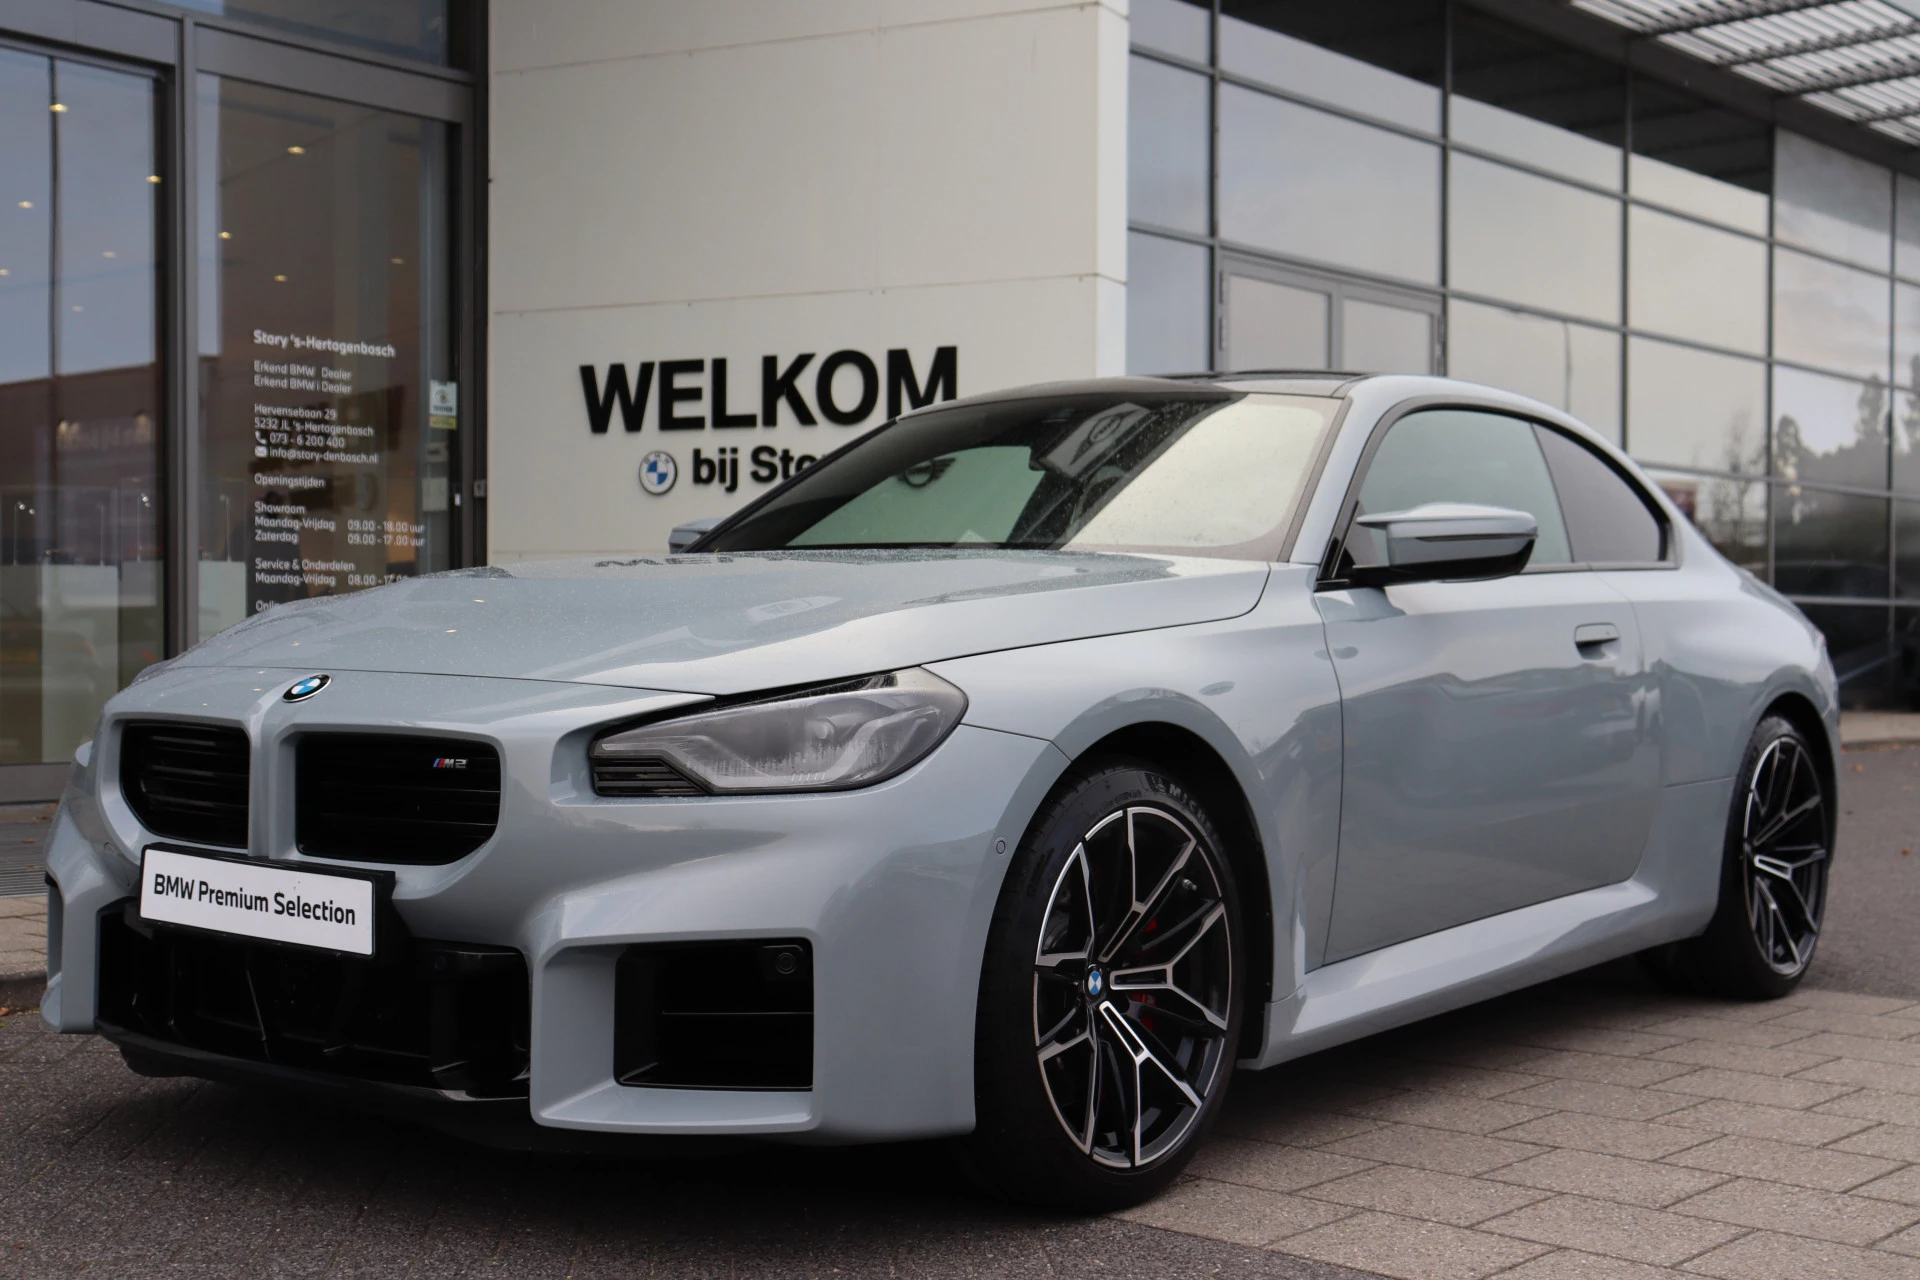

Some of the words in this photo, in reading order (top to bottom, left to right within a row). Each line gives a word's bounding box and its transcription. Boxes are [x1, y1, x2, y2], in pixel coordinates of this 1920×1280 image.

[253, 329, 289, 349] Story
[290, 334, 395, 357] 's-Hertogenbosch
[254, 360, 287, 375] Erkend
[290, 363, 315, 376] BMW
[321, 366, 352, 381] Dealer
[254, 374, 287, 389] Erkend
[290, 377, 315, 391] BMW
[321, 380, 352, 394] Dealer
[579, 345, 958, 435] WELKOM
[254, 404, 322, 419] Hervensebaan
[324, 408, 337, 420] 29
[254, 417, 278, 430] 5232
[280, 419, 290, 430] JL
[292, 421, 374, 437] 's-Hertogenbosch
[269, 432, 287, 445] 073
[296, 434, 303, 446] 6
[305, 434, 323, 447] 200
[325, 435, 345, 448] 400
[269, 447, 377, 463] info@story-denbosch.nl
[692, 447, 740, 493] bij
[254, 473, 325, 489] Openingstijden
[255, 501, 305, 515] Showroom
[255, 517, 336, 531] Maandag-Vrijdag
[347, 519, 375, 532] 09.00
[383, 520, 408, 533] 18.00
[409, 524, 425, 534] uur
[255, 530, 299, 544] Zaterdag
[347, 533, 375, 546] 09.00
[383, 534, 408, 547] 17.00
[409, 537, 425, 547] uur
[255, 558, 290, 570] Service
[291, 559, 300, 570] &
[301, 559, 356, 572] Onderdelen
[255, 572, 336, 587] Maandag-Vrijdag
[347, 574, 376, 586] 08.00
[153, 872, 195, 900] BMW
[198, 881, 269, 913] Premium
[273, 892, 356, 926] Selection
